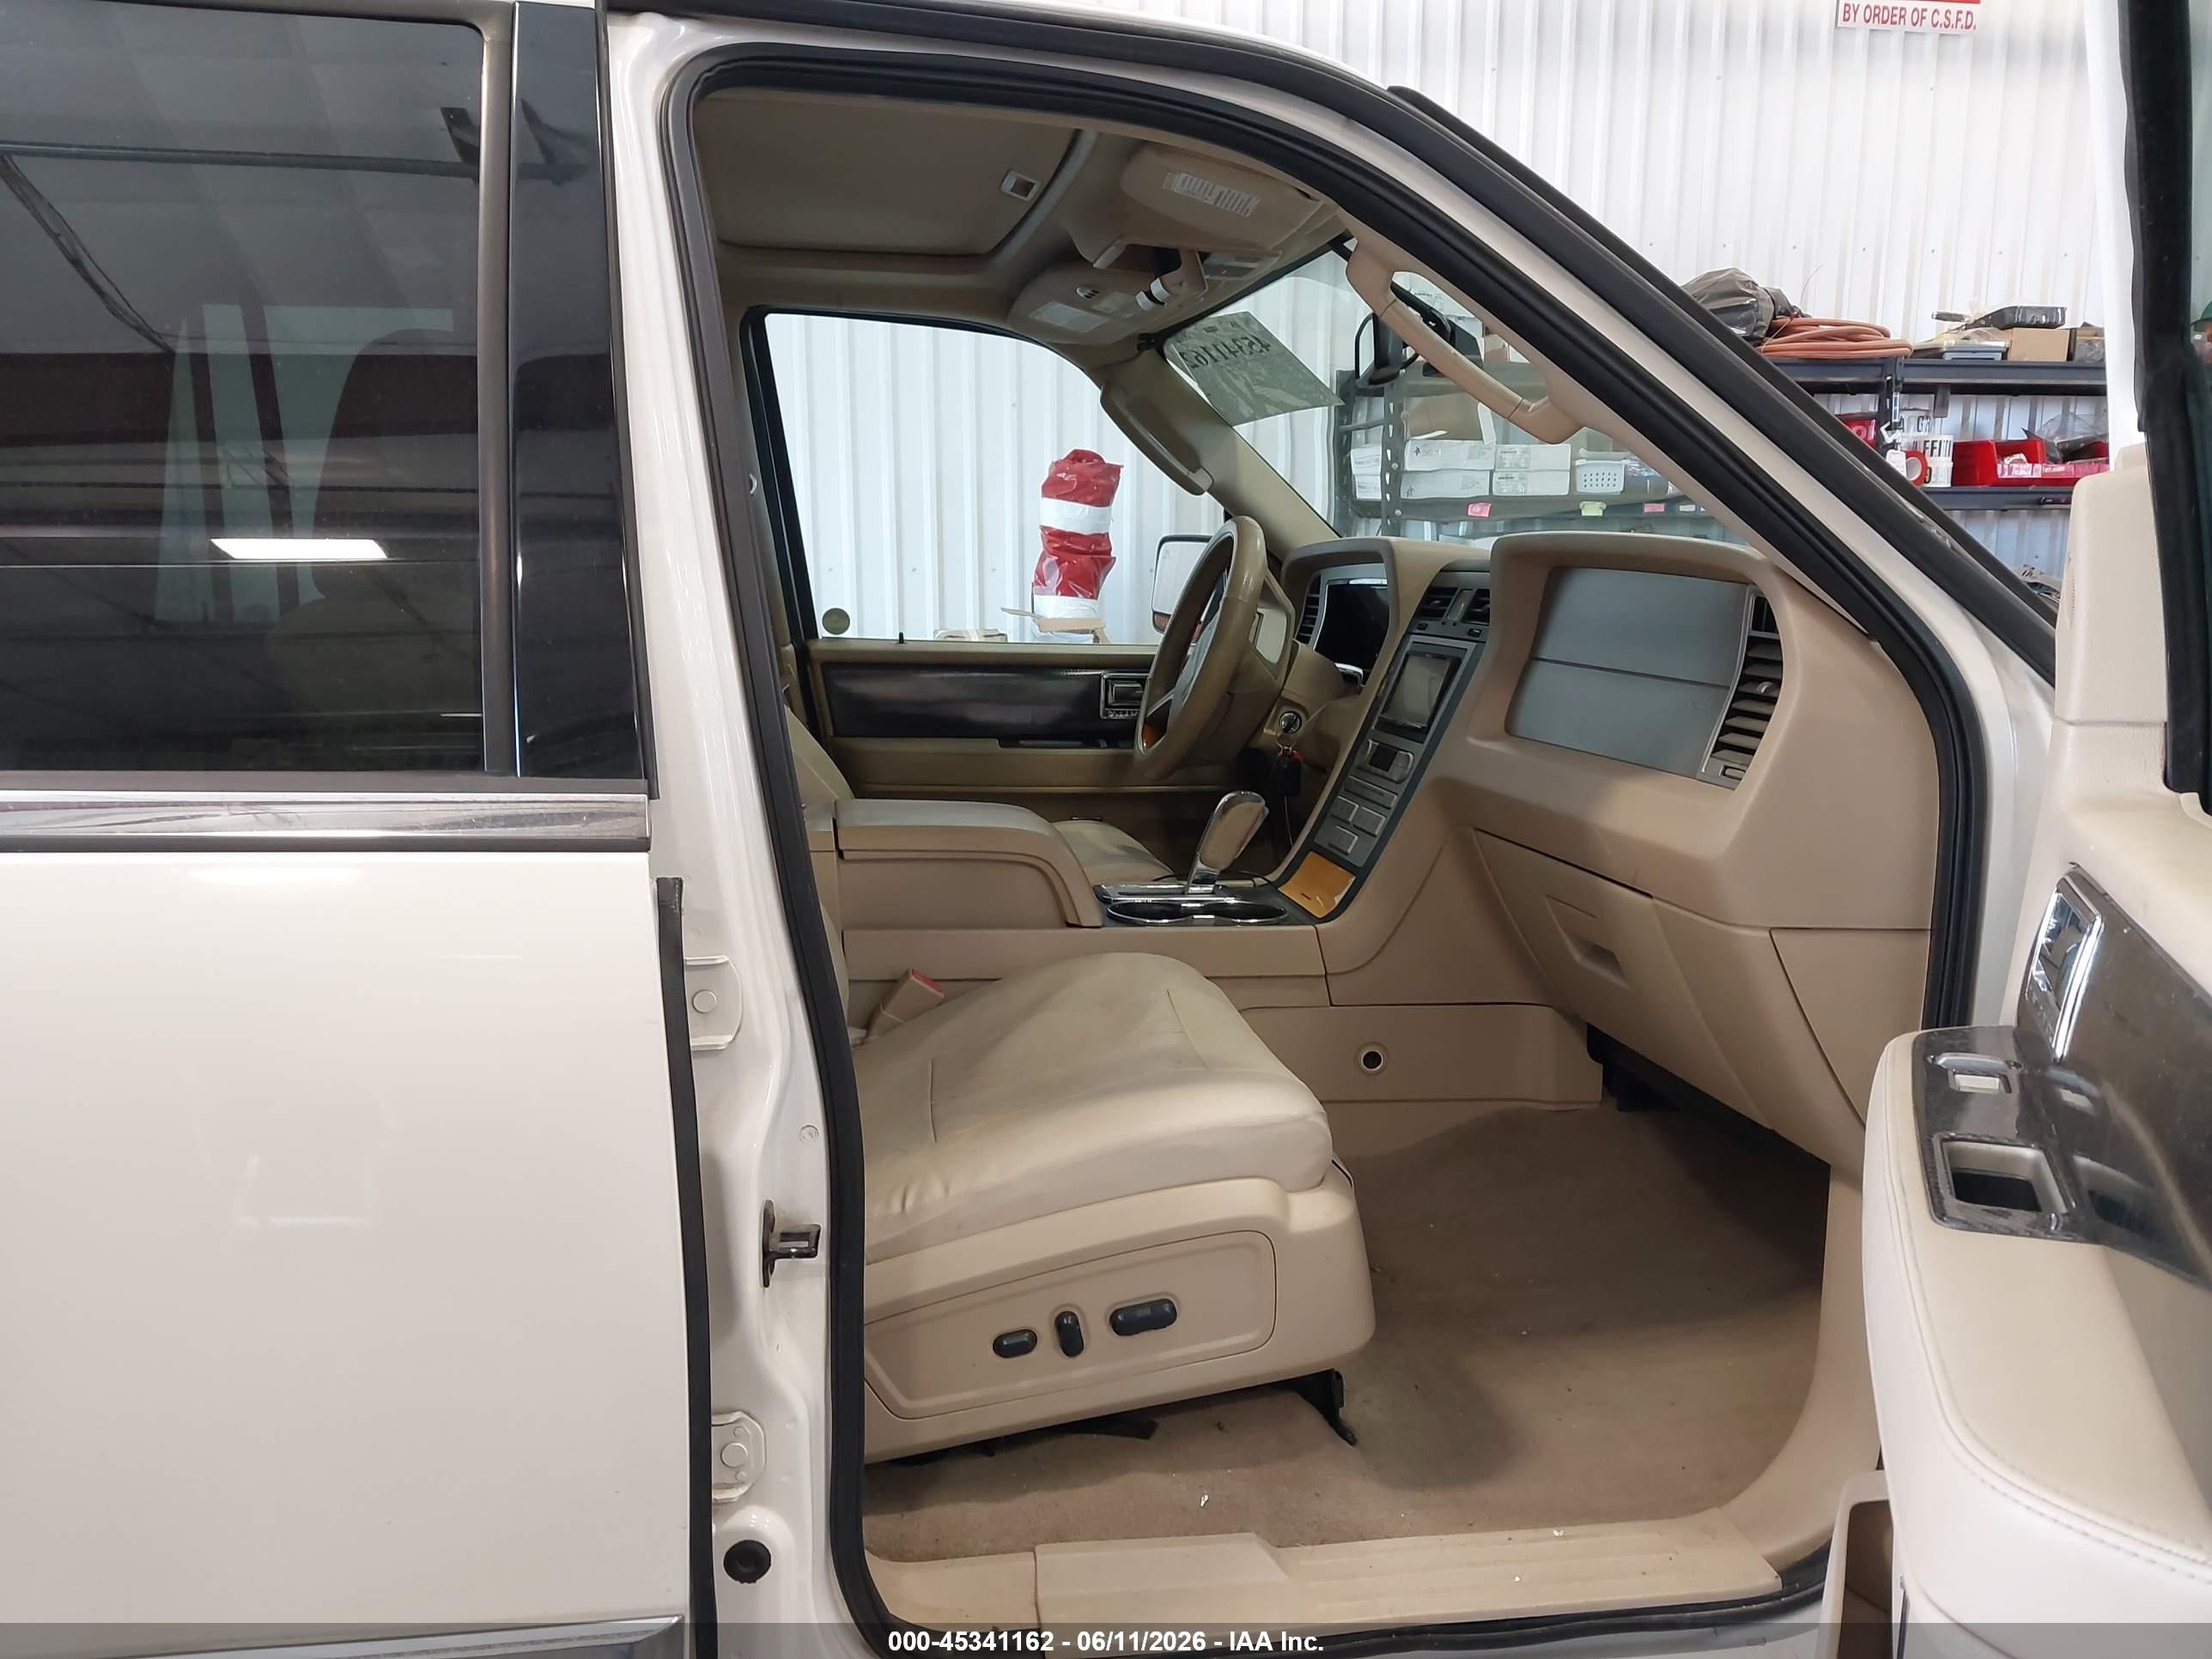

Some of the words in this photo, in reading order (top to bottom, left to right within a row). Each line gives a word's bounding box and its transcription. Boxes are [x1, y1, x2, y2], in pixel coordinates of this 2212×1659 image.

[1842, 3, 1860, 23] BY
[1863, 4, 1907, 26] ORDER
[1911, 7, 1928, 27] OF
[1931, 9, 1977, 31] C.S.F.D.
